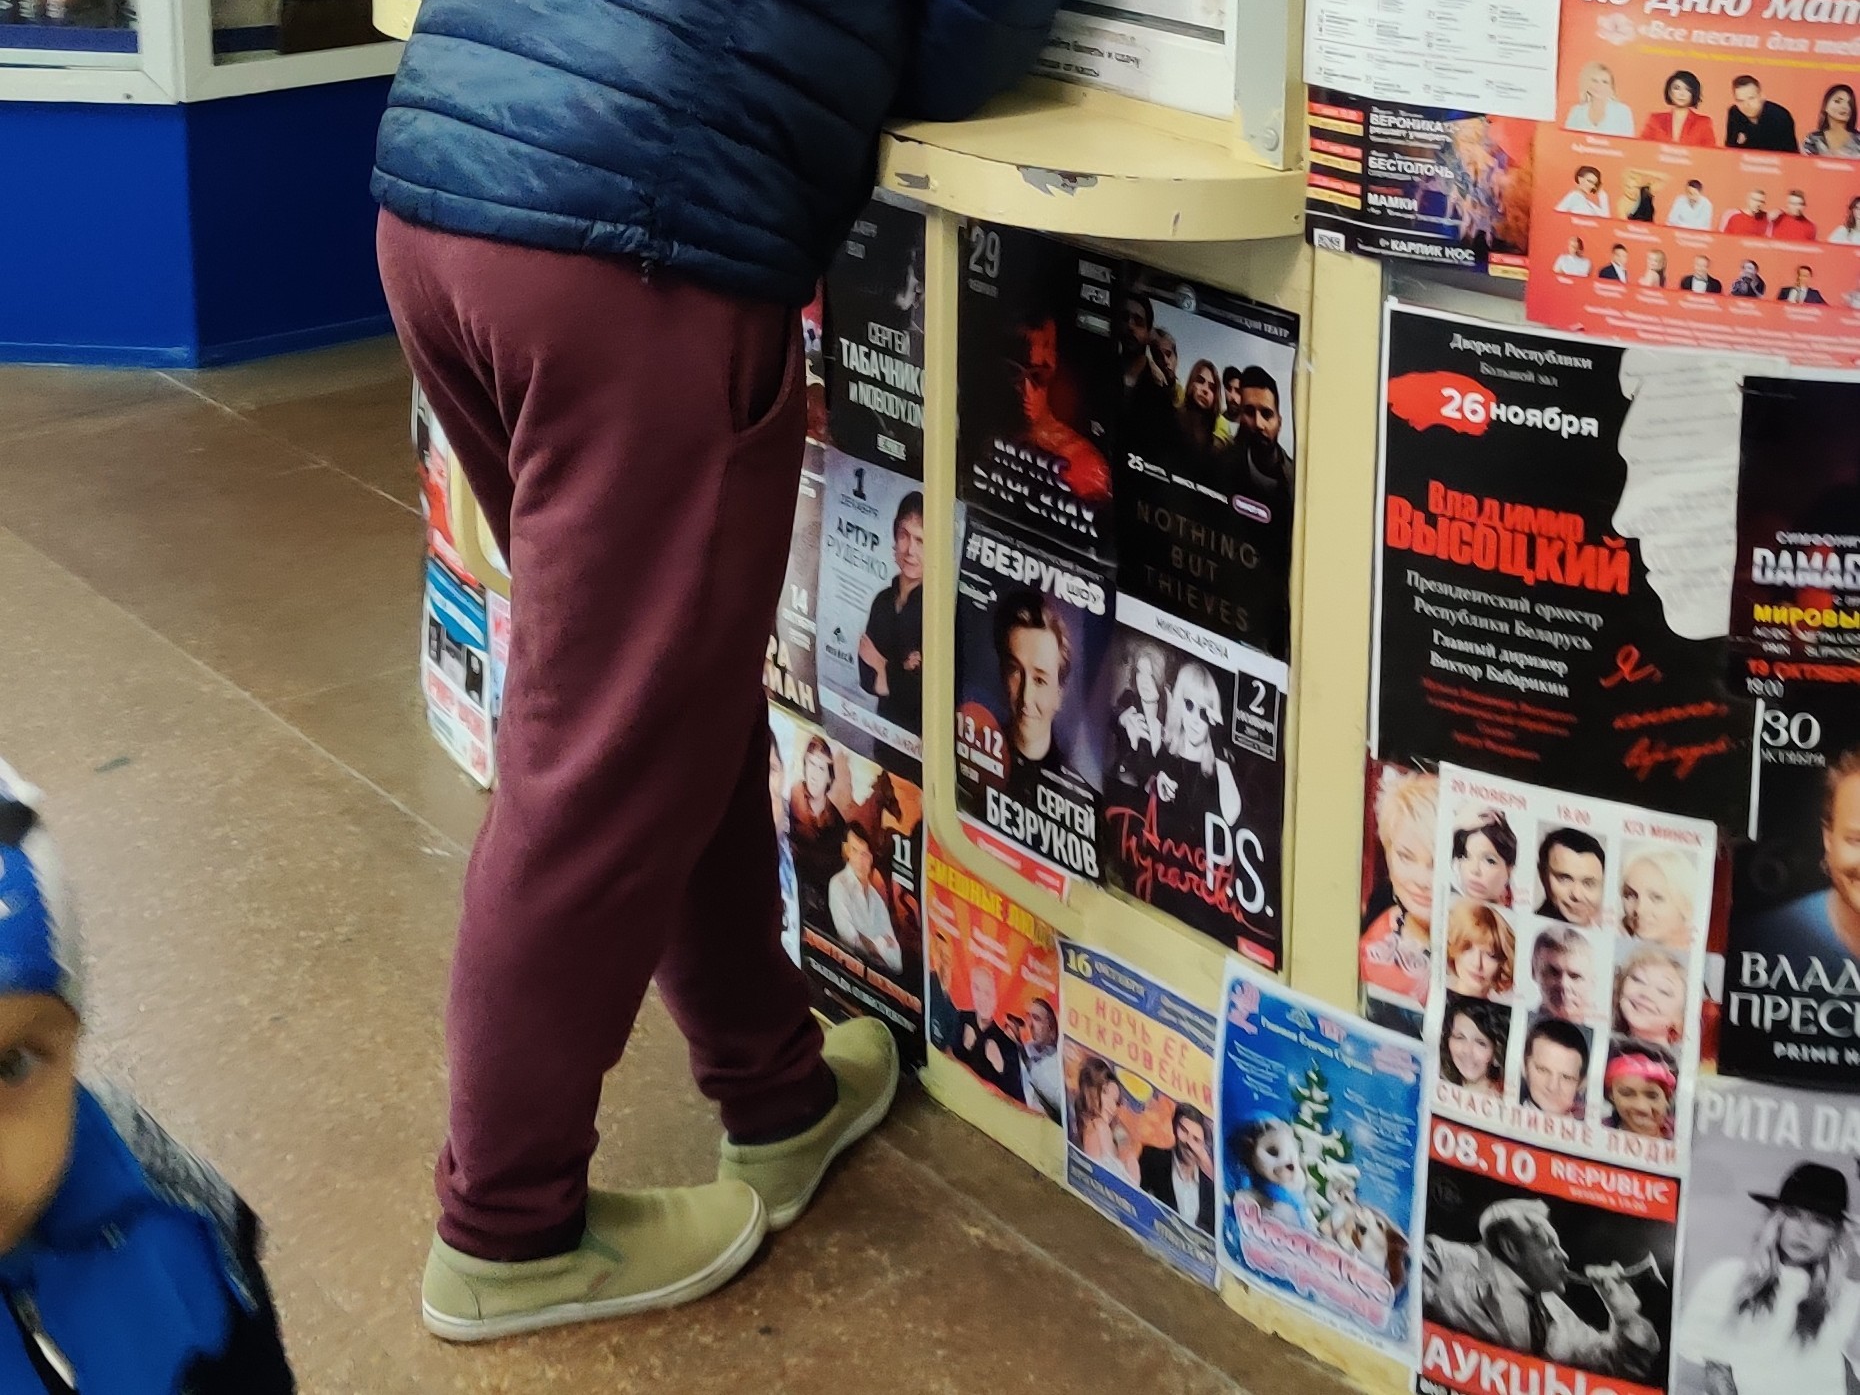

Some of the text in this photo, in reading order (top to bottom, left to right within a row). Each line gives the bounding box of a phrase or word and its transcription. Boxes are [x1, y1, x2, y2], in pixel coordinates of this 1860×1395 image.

[1690, 29, 1760, 49] песни
[1369, 112, 1444, 133] ВЕРОНИКА
[1368, 156, 1454, 179] БЕСТОЛОЧЬ
[1367, 192, 1419, 212] МАМКИ
[969, 226, 1000, 279] 29
[1391, 238, 1476, 262] КАРЛИК НОС
[868, 321, 911, 358] СЕРГЕЙ
[1449, 332, 1593, 370] Дворец Республики
[1439, 387, 1599, 439] 26 ноября
[852, 467, 867, 502] 1
[1127, 452, 1145, 472] 25
[836, 516, 880, 553] АРТУР
[1137, 500, 1259, 569] NOTHING
[826, 534, 889, 582] РУДЕНКО
[966, 533, 1106, 615] #БЕЗРУКОВ
[1172, 545, 1218, 582] BUT
[1144, 564, 1249, 632] THIEVES
[1406, 568, 1604, 632] Президентский оркестр
[1413, 595, 1593, 651] Республики Беларусь
[1432, 628, 1497, 660] Главный
[1429, 650, 1484, 682] Виктор
[1249, 680, 1267, 716] 2
[956, 711, 1004, 760] 13.12
[1761, 708, 1821, 750] 30
[985, 784, 1099, 880] БЕЗРУКОВ
[1036, 784, 1096, 842] СЕРГЕЙ
[891, 834, 913, 871] 11
[1204, 811, 1275, 918] P.S.
[927, 853, 1004, 923] СМЕШНЫЕ
[1066, 949, 1093, 978] 16
[1095, 997, 1153, 1045] НОЧЬ
[1436, 1083, 1678, 1165] СЧАСТЛИВЫЕ ЛЮДИ
[1696, 1089, 1804, 1152] РИТА
[1433, 1124, 1538, 1184] 08.10
